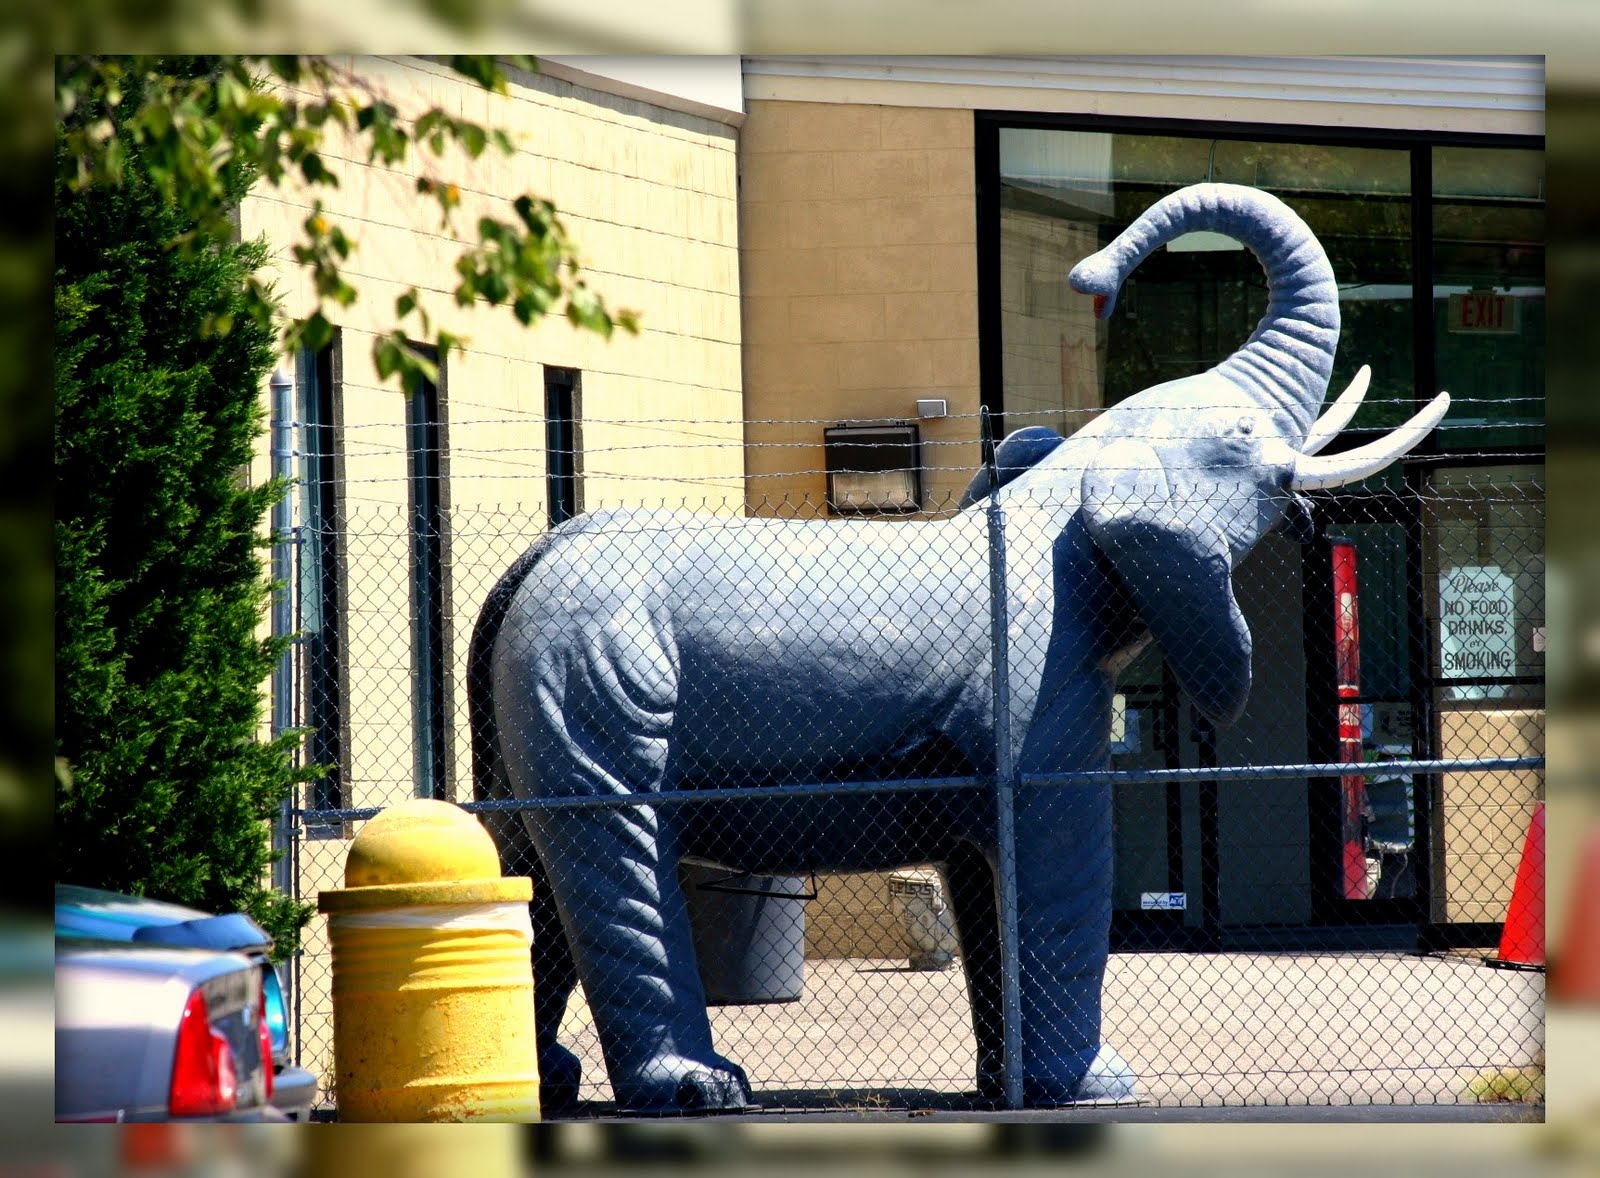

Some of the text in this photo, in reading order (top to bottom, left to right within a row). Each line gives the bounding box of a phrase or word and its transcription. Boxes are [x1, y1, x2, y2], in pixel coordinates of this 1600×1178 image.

[1463, 296, 1504, 327] EXIT
[1452, 575, 1499, 593] Please
[1444, 600, 1510, 616] NO FOOD,
[1448, 620, 1508, 636] DRINKS,
[1469, 639, 1481, 648] or
[1444, 651, 1511, 670] SMOKING
